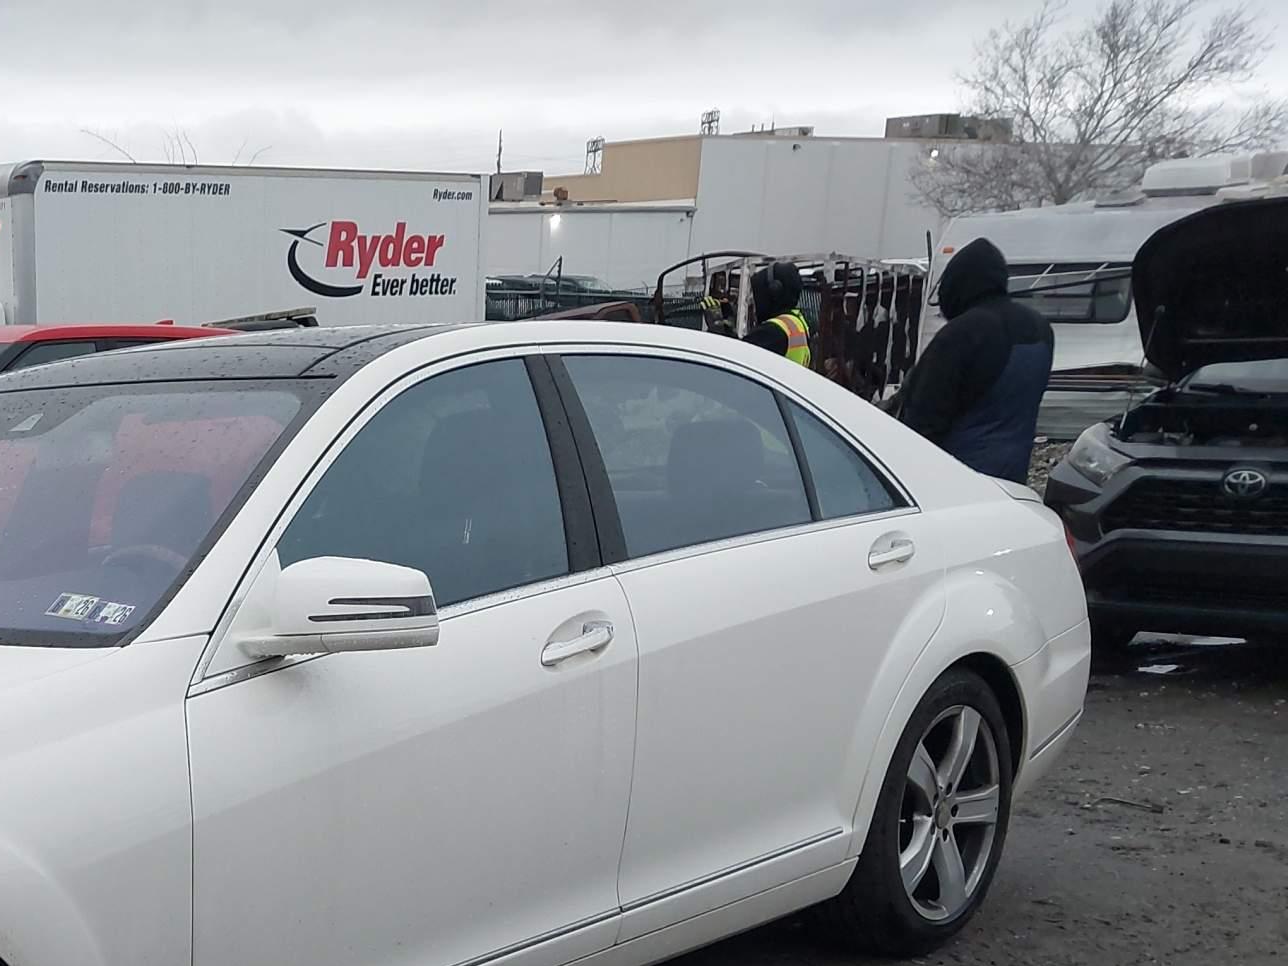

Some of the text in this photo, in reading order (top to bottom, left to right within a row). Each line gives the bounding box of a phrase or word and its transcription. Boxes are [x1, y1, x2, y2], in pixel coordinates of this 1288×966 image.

[45, 180, 230, 196] Rental Reservations: 1-800-BY-RYDER
[433, 188, 472, 202] Ryder.com
[325, 221, 445, 279] Ryder
[371, 273, 456, 296] Ever better.
